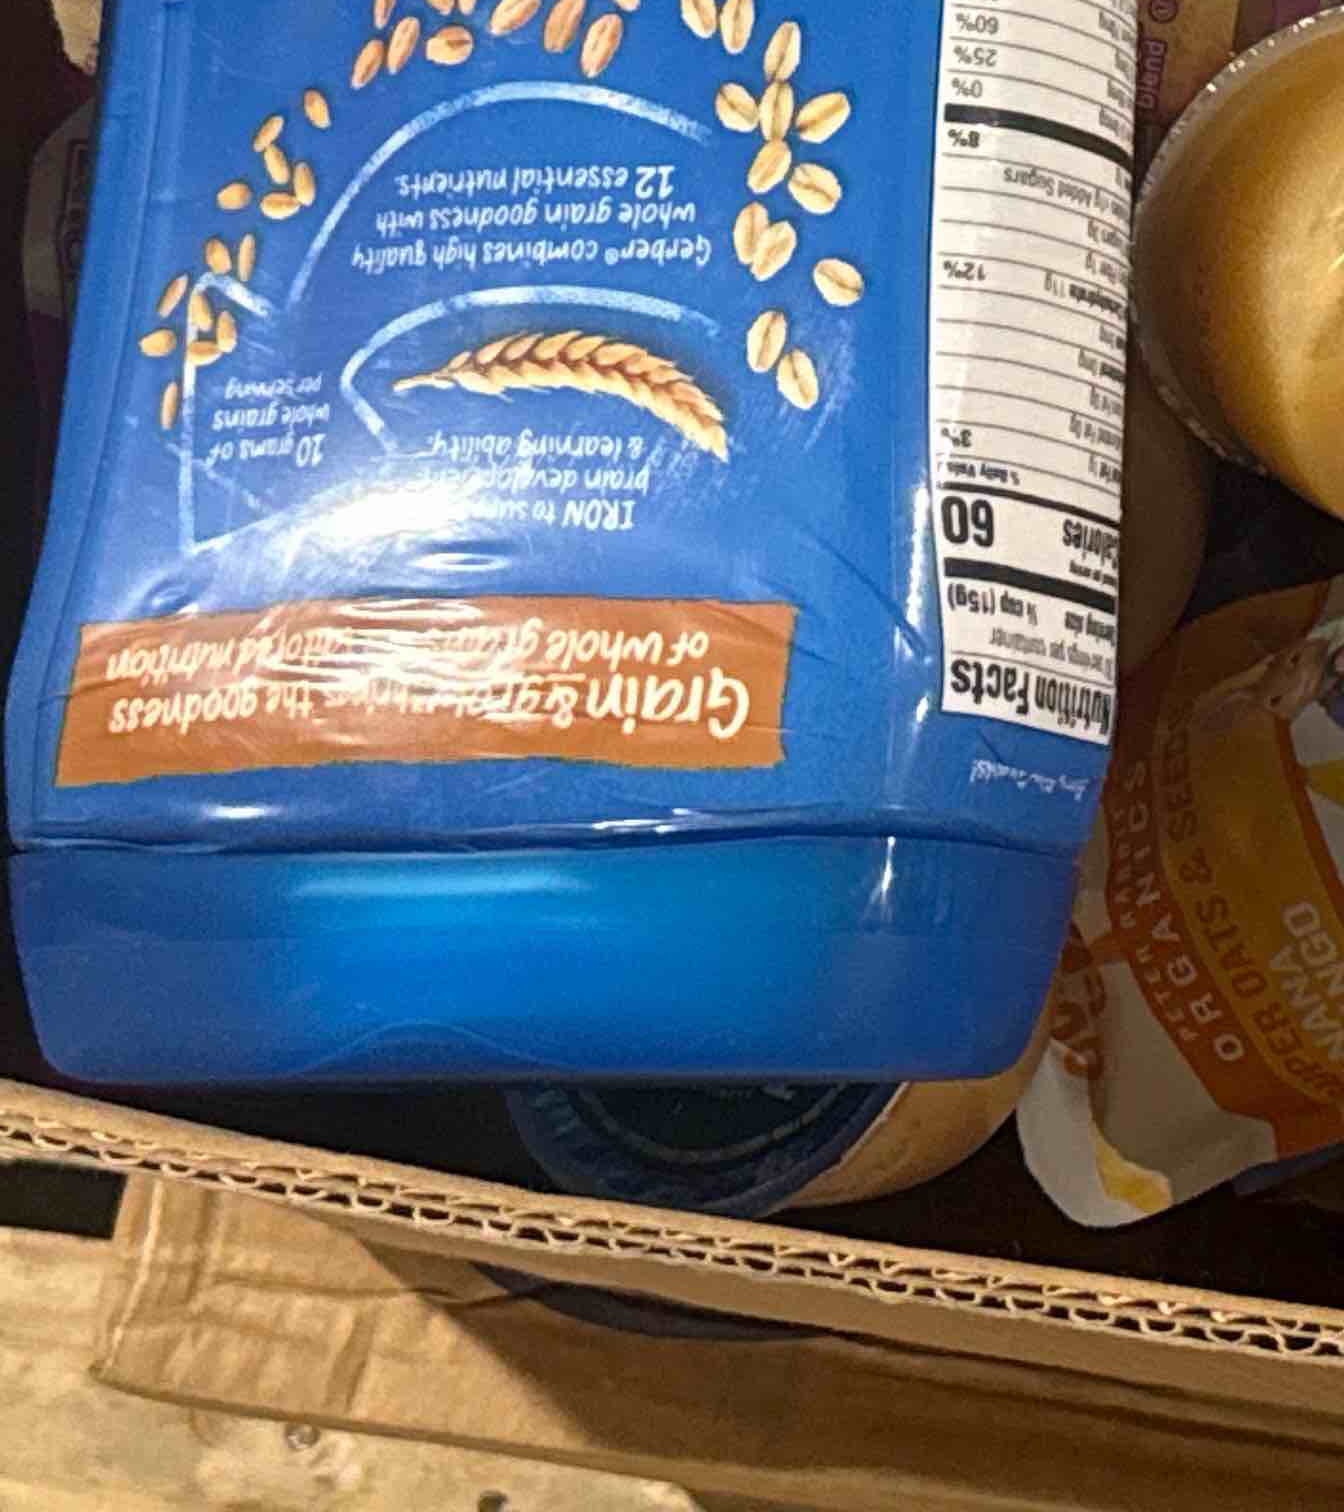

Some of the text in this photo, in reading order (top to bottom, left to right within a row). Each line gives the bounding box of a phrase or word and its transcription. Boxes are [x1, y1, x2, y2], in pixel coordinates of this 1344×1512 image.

[510, 164, 628, 195] essential
[634, 164, 674, 199] 12
[375, 199, 695, 234] whole grain goodness with
[350, 240, 426, 274] quality
[431, 238, 476, 269] high
[482, 238, 597, 266] combines
[561, 498, 635, 530] IRON
[940, 495, 994, 548] 60
[585, 665, 749, 739] Grain
[949, 658, 1029, 716] Facts
